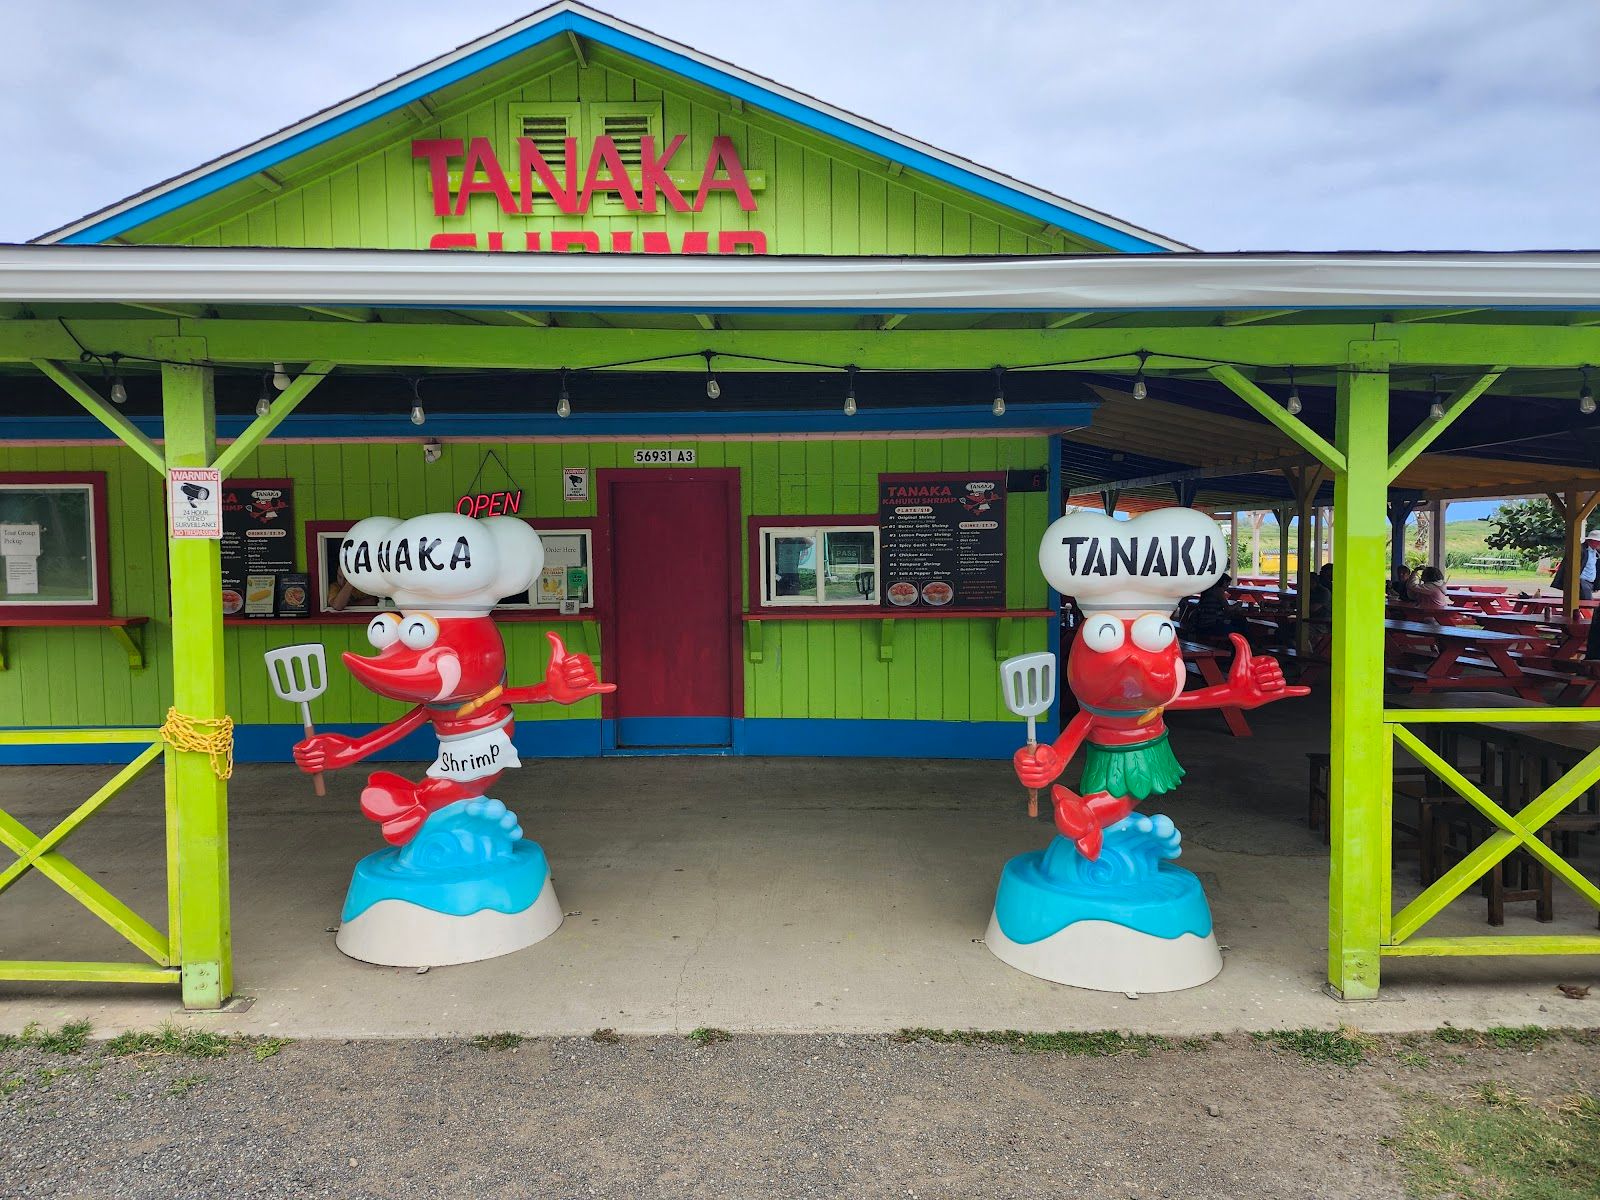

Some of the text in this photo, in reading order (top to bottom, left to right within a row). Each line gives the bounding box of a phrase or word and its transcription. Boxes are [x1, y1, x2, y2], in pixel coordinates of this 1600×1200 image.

[412, 135, 757, 216] TANAKA
[636, 451, 692, 462] 56931 A3
[172, 472, 218, 480] WARNING
[456, 490, 522, 518] OPEN
[888, 486, 952, 496] TANAKA
[342, 536, 471, 574] TANAKA
[1062, 536, 1216, 576] TANAKA
[440, 744, 500, 772] Shrimp
